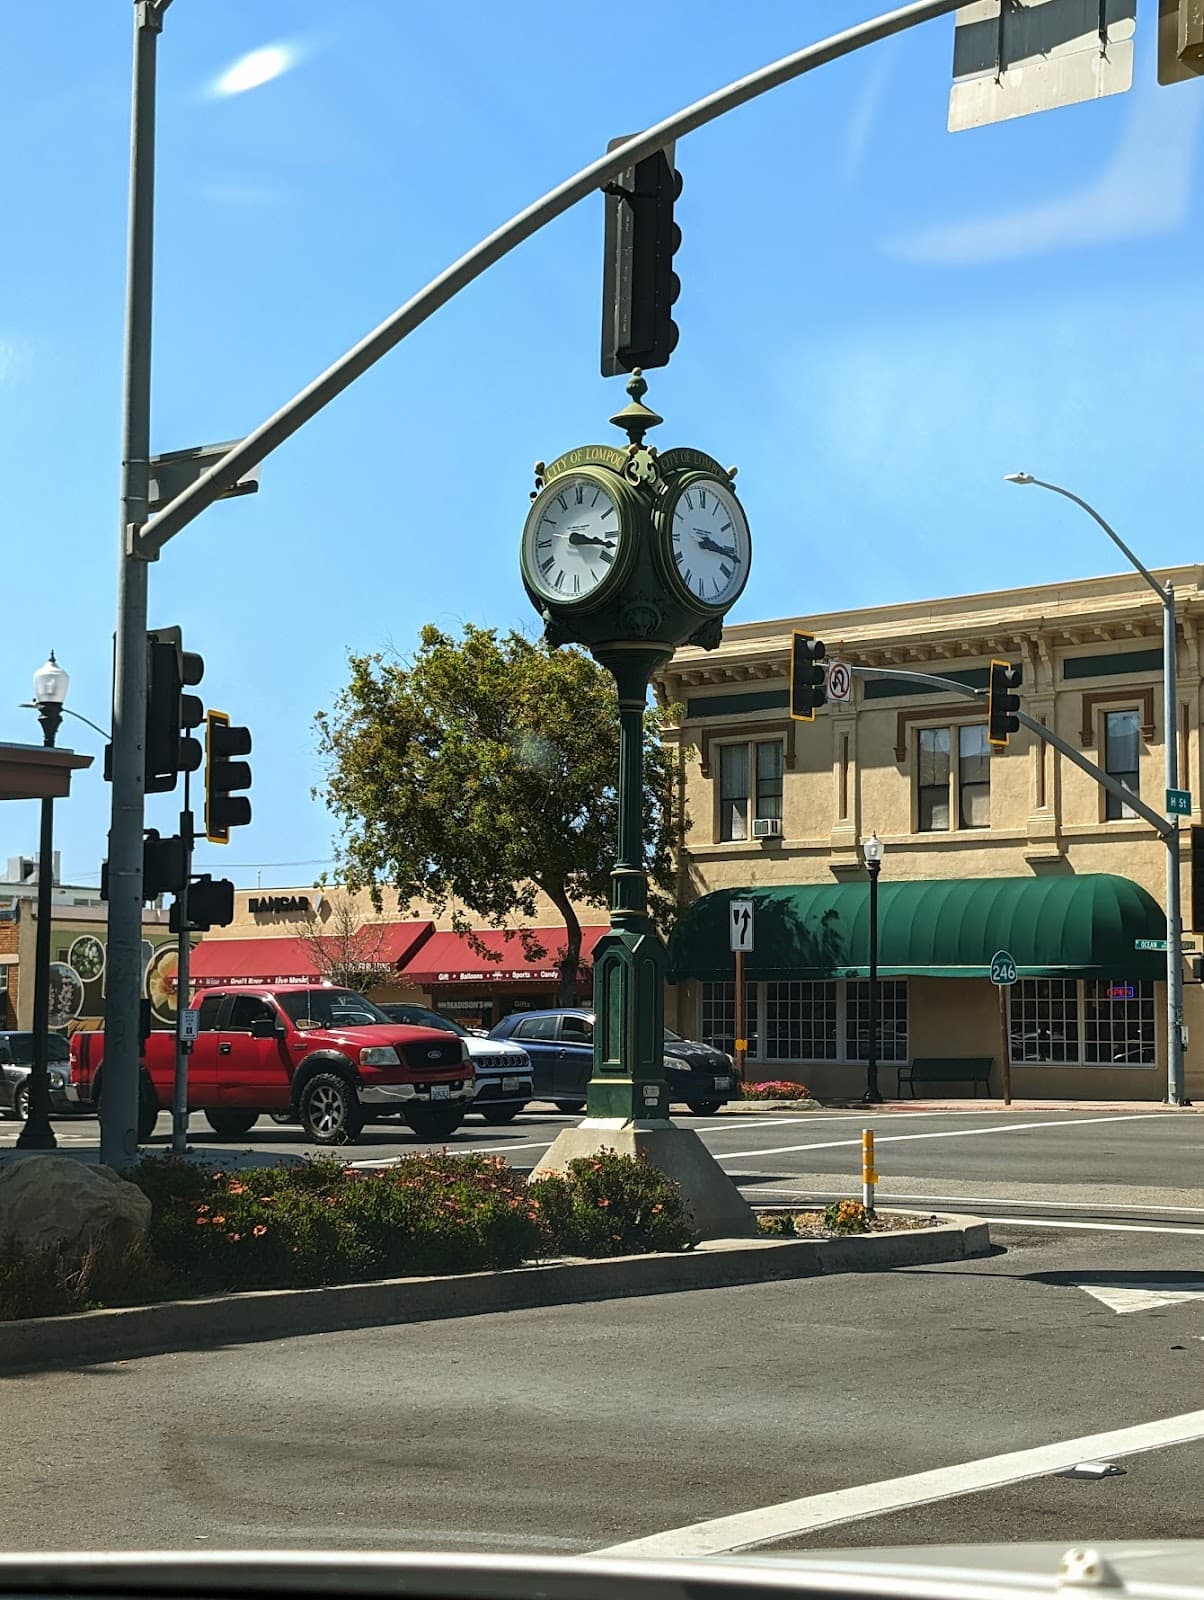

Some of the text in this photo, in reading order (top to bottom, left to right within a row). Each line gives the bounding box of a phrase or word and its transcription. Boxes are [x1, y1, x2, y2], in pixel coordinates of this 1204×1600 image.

[546, 447, 626, 480] CITY OF LOMPOC
[1170, 796, 1187, 808] H St
[438, 970, 559, 981] Gift Balloons Sports Candy
[992, 964, 1016, 980] 246
